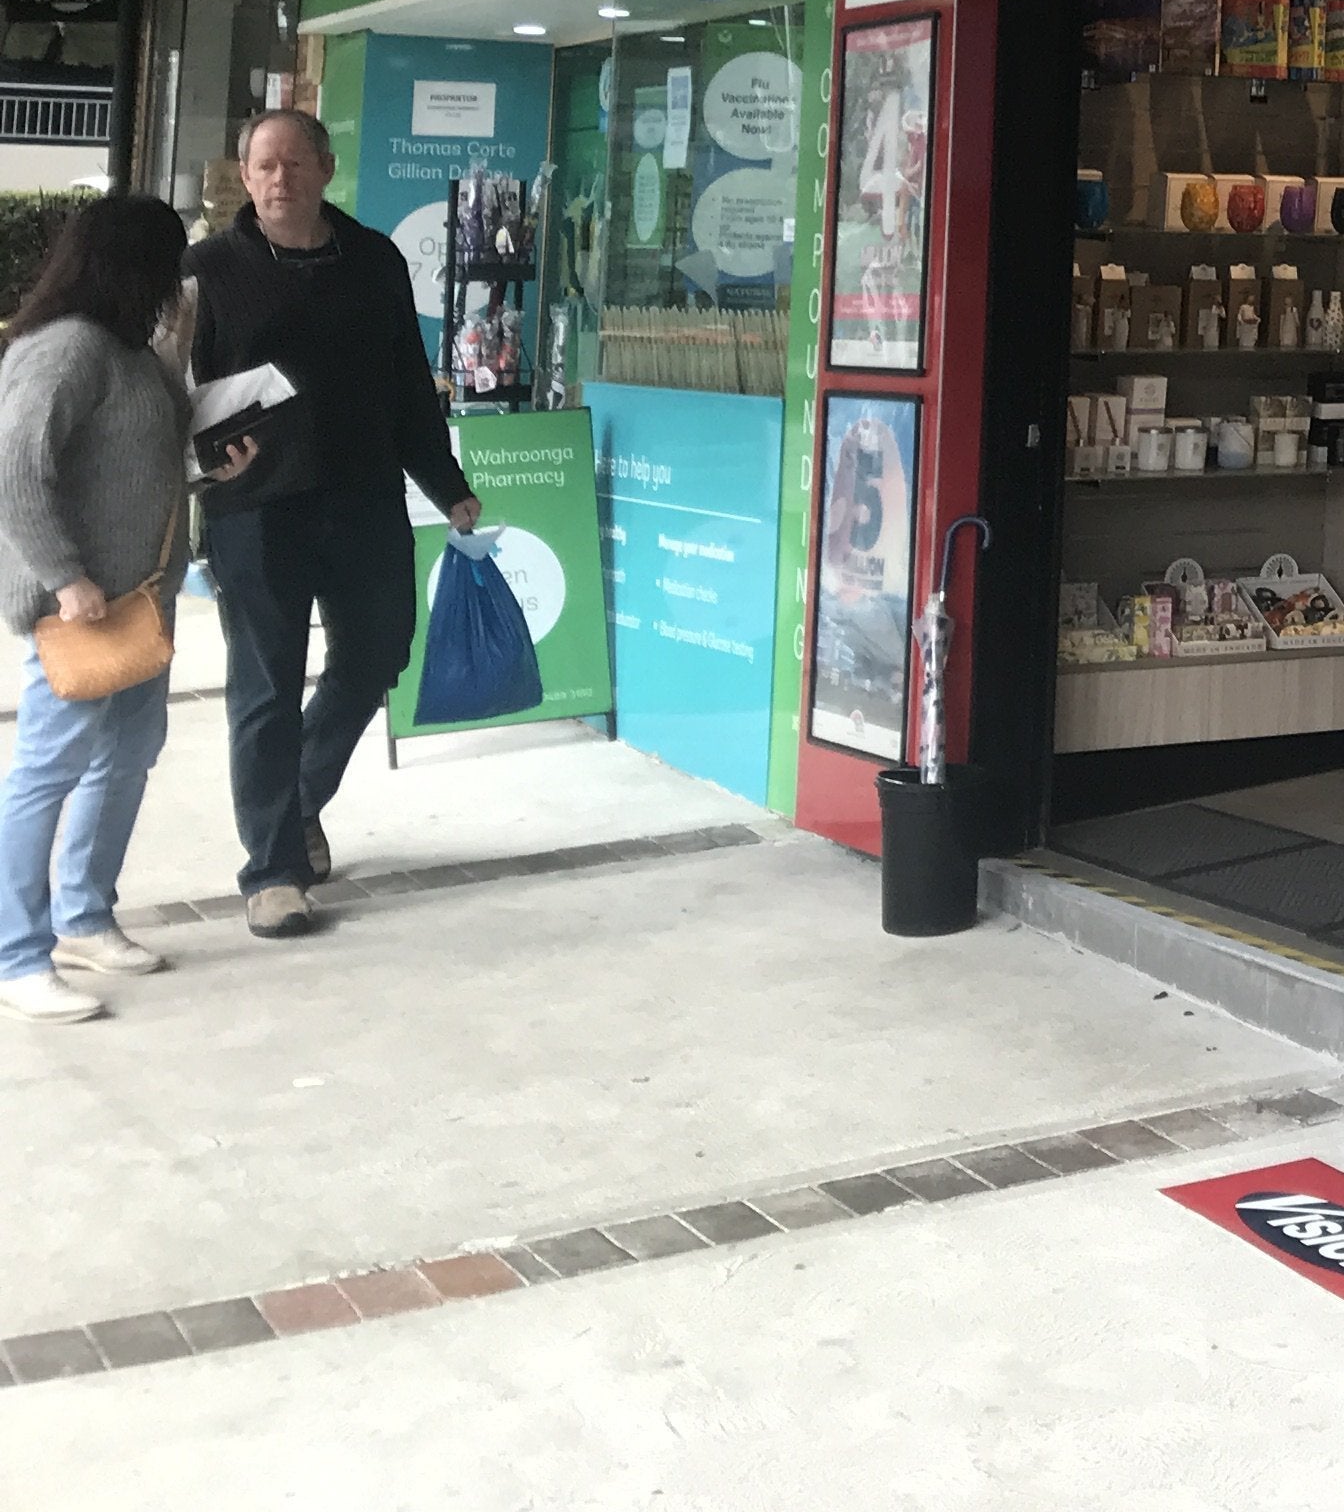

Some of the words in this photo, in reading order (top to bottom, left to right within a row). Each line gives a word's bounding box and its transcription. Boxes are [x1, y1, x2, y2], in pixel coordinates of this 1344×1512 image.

[389, 138, 461, 156] Thomas
[388, 163, 443, 180] Gillian
[469, 445, 574, 467] Wahroonga
[472, 468, 565, 489] Pharmacy
[618, 455, 628, 478] to
[631, 454, 650, 489] help
[652, 465, 671, 491] you
